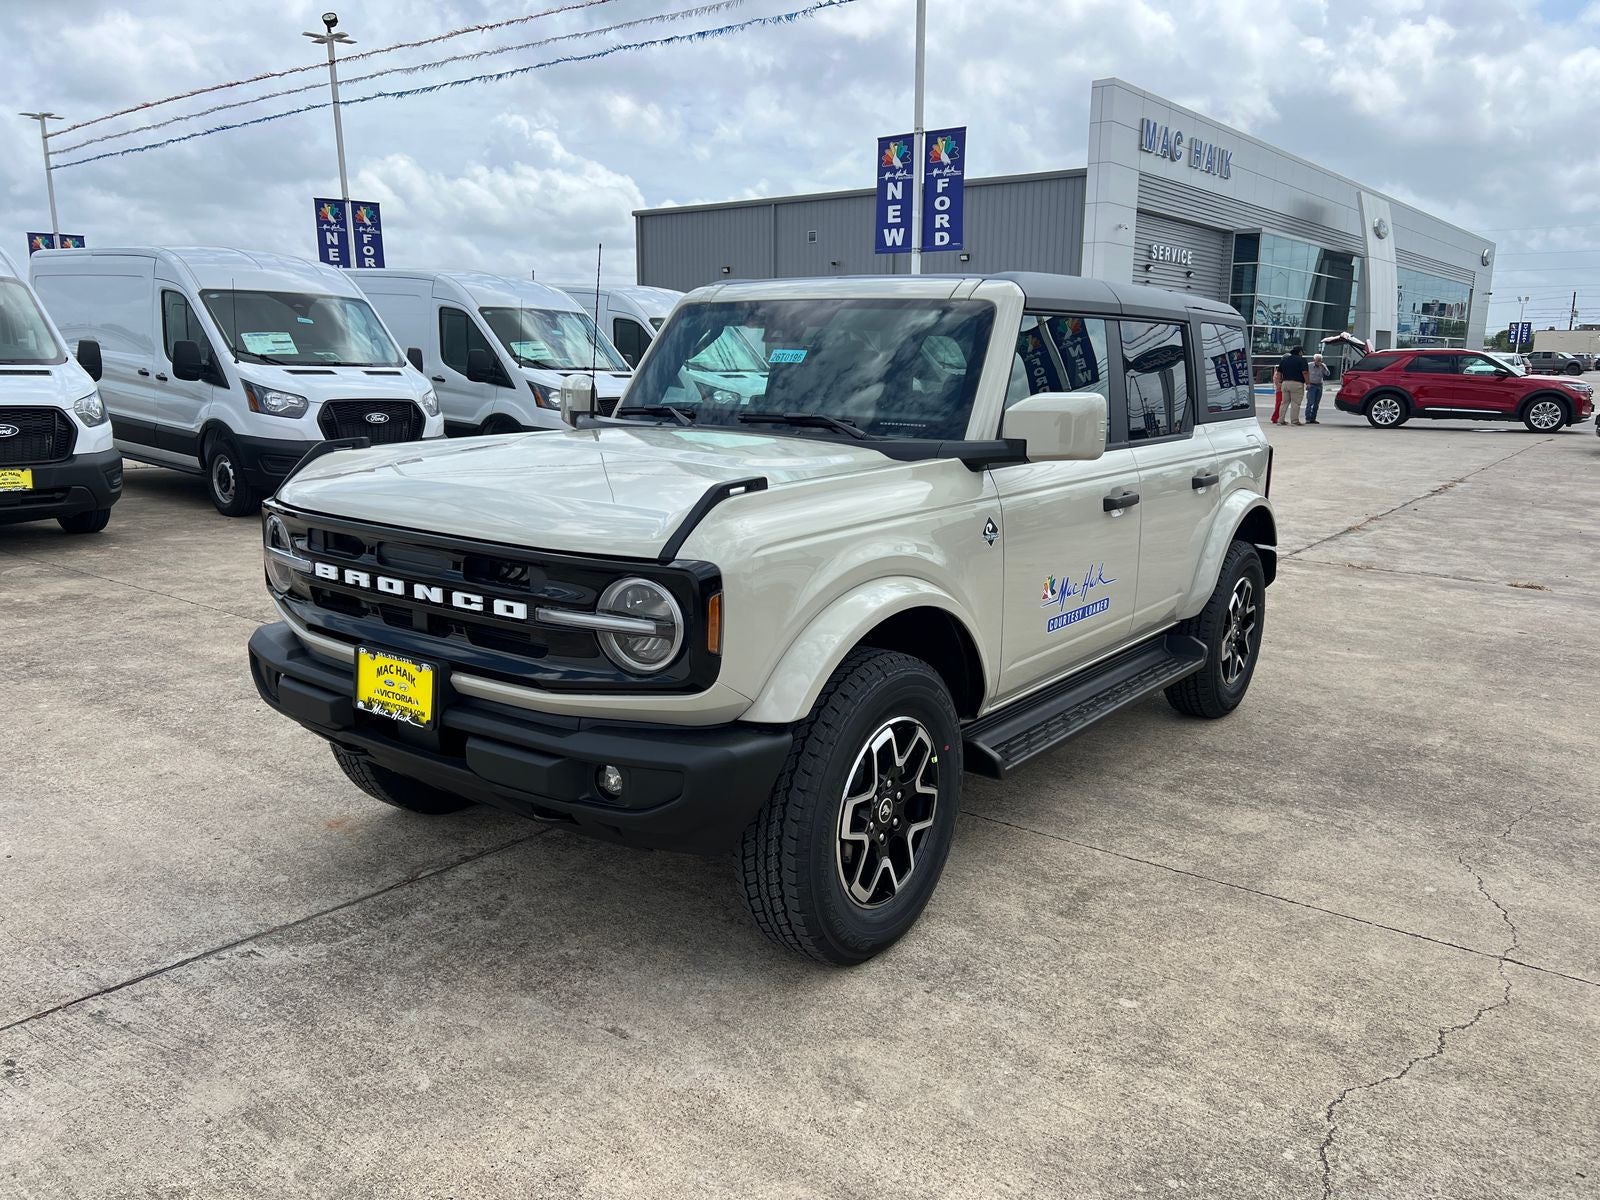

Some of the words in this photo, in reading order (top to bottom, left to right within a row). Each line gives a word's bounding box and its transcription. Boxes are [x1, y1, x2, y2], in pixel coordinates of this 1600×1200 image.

[1140, 118, 1184, 162] MAC
[1189, 137, 1233, 179] HAIK
[883, 181, 905, 247] NEW
[934, 178, 951, 246] FORD
[326, 232, 343, 268] NE
[362, 234, 376, 268] FOR
[1150, 243, 1193, 265] SERVICE
[314, 561, 528, 620] BRONCO
[1050, 577, 1080, 611] Mac
[1081, 563, 1115, 602] Haik
[1049, 610, 1082, 631] COURTESY
[1085, 599, 1108, 617] LOANER
[376, 664, 394, 678] MAC
[396, 665, 417, 687] HAIK
[379, 689, 413, 703] VICTORIA
[369, 704, 391, 717] Mac
[391, 710, 416, 724] Haik
